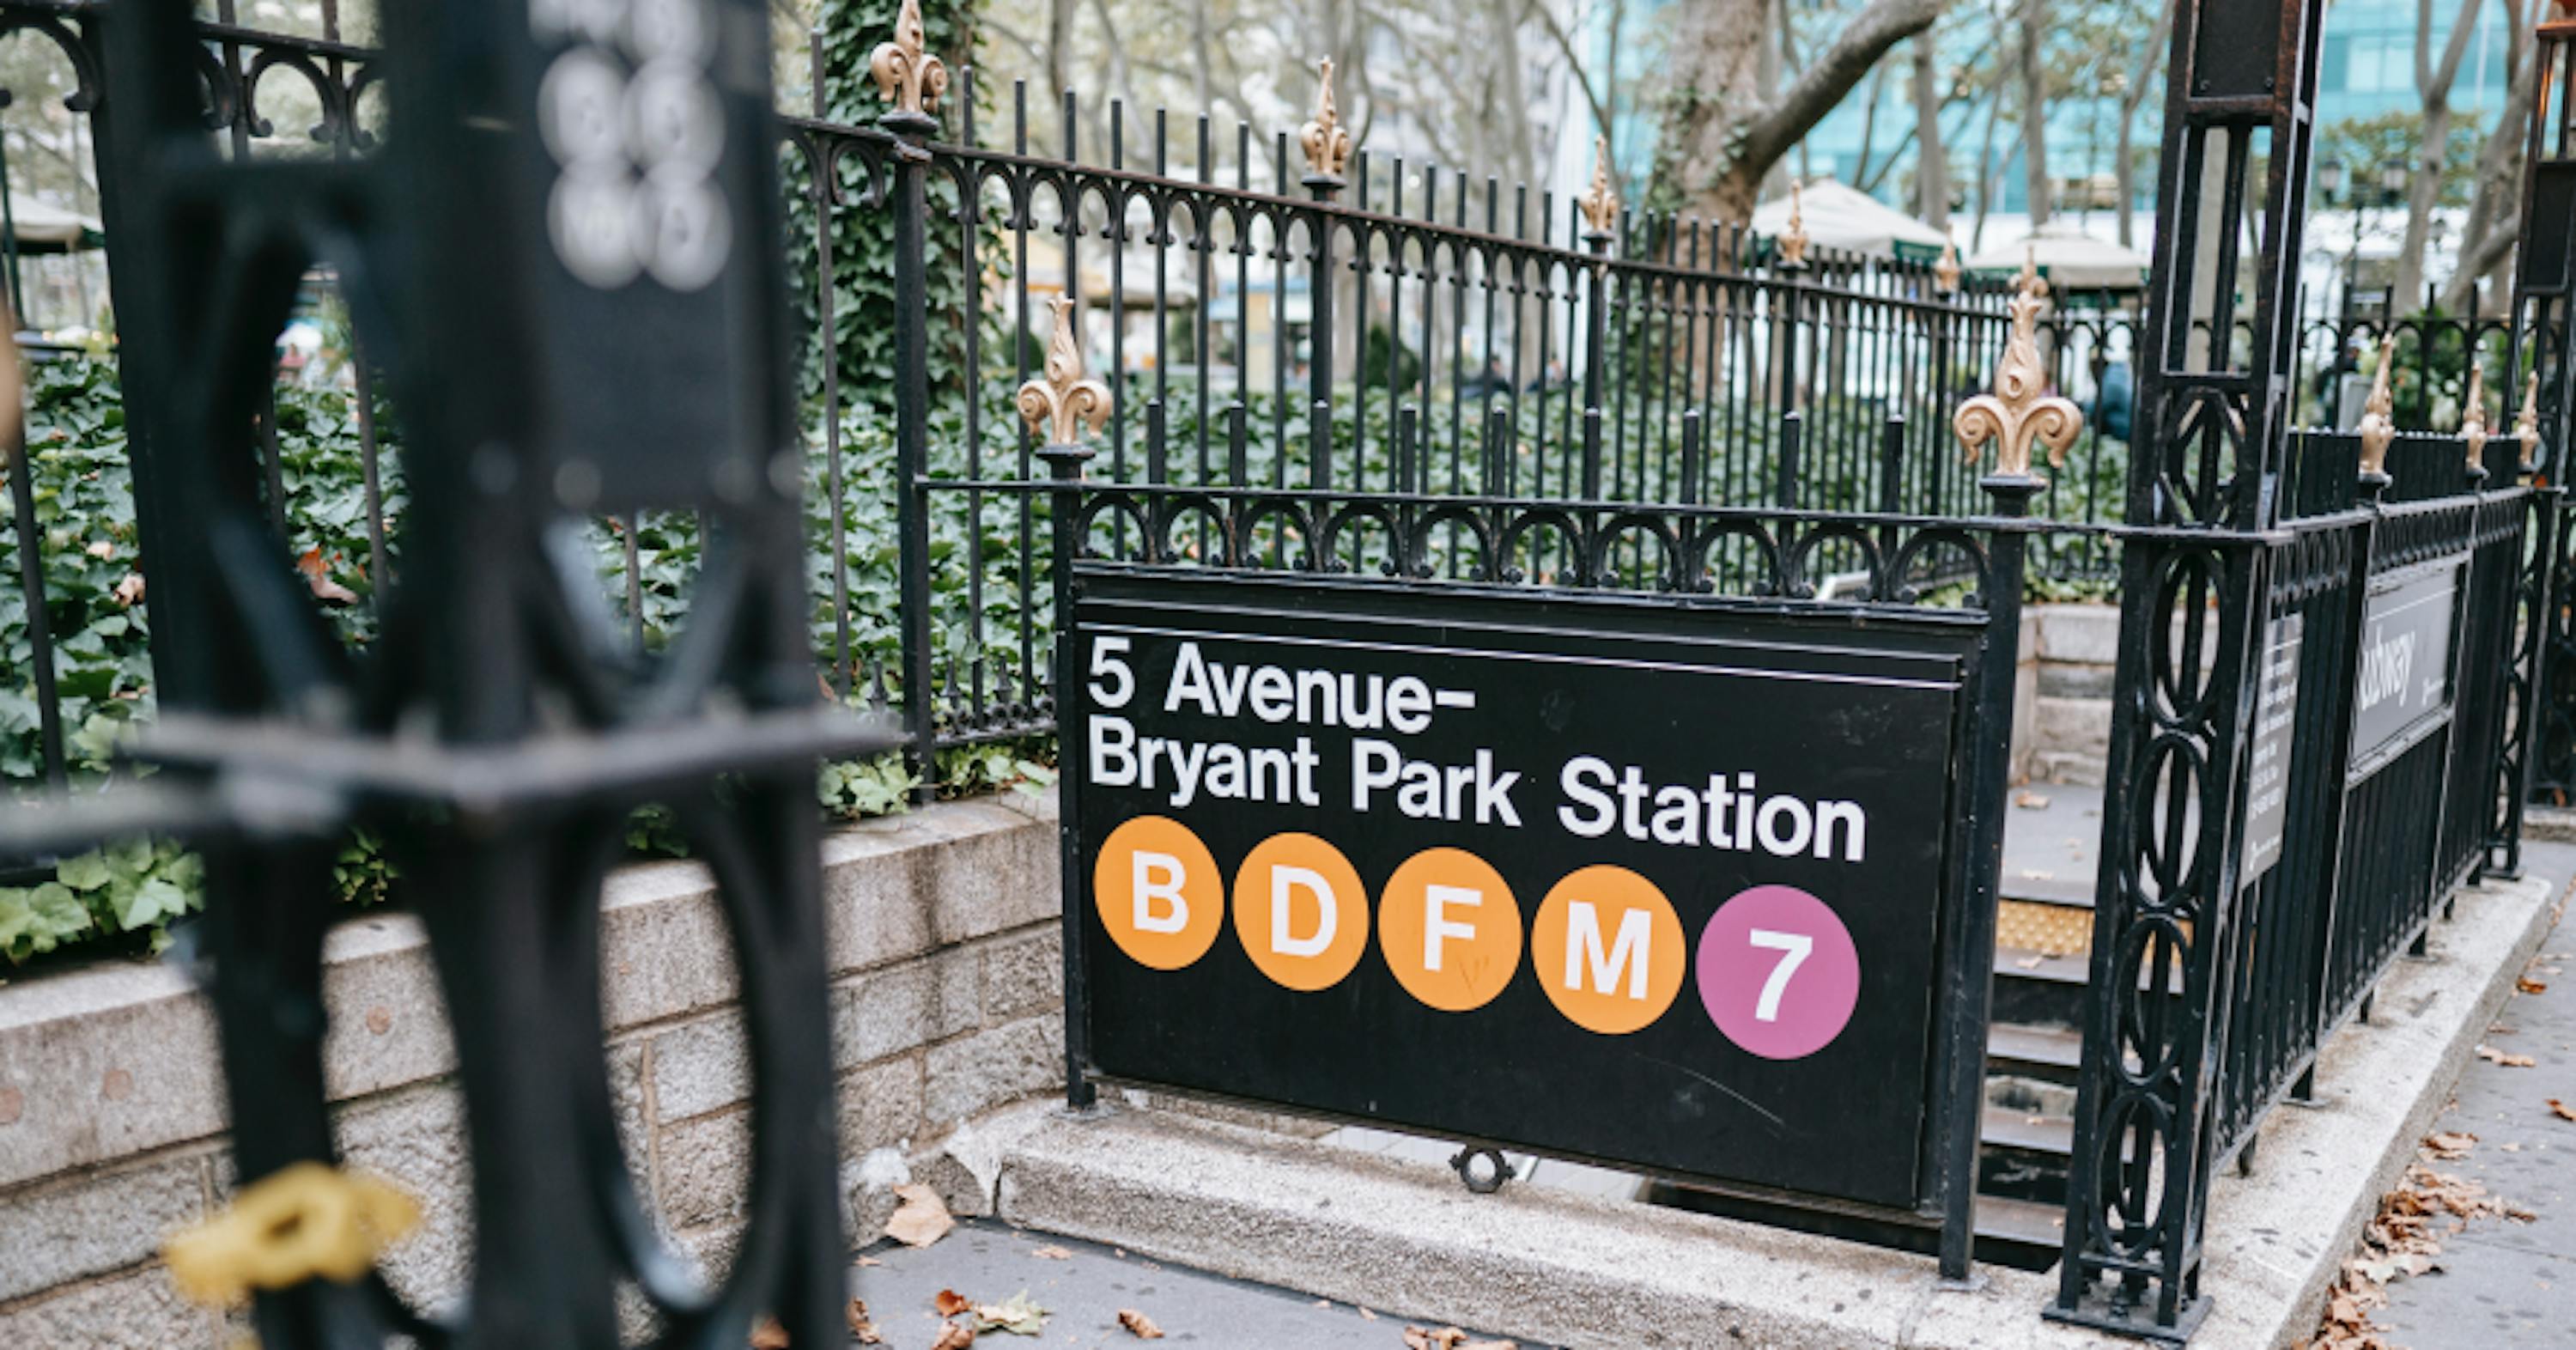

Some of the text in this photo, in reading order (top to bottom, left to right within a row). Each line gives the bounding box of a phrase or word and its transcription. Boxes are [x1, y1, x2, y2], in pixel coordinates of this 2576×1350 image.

[1088, 635, 1135, 709] 5
[2360, 623, 2416, 712] ubway
[1089, 715, 1866, 861] Bryant Park Station
[1132, 849, 1814, 1023] B D F M 7
